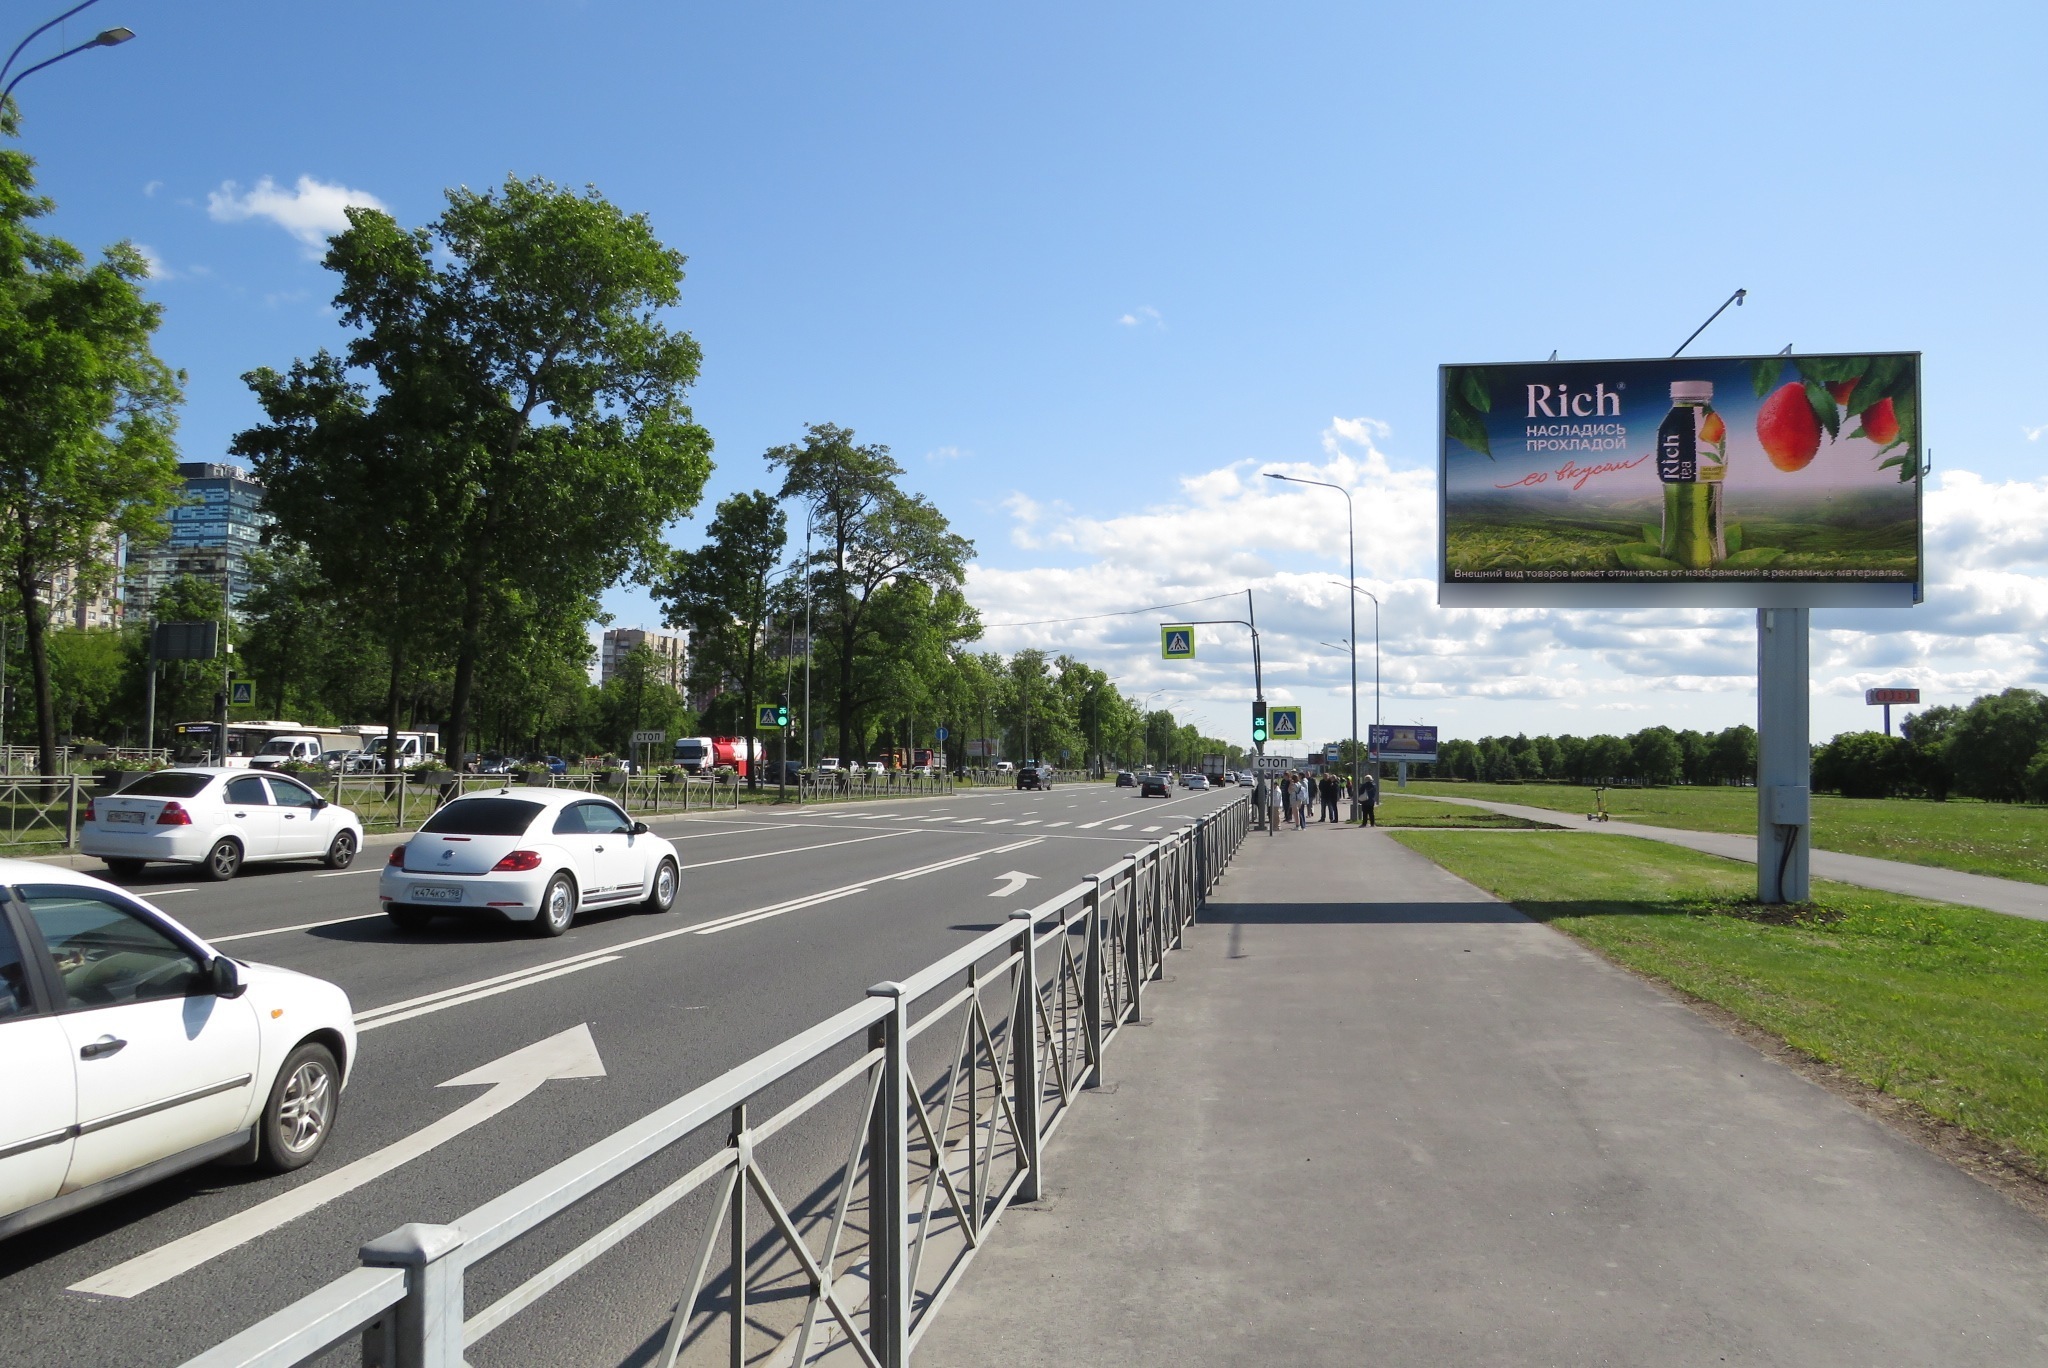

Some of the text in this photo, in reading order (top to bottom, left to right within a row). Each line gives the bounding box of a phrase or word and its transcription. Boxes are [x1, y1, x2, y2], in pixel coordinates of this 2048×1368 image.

[1525, 383, 1621, 418] Rich
[1526, 423, 1626, 437] НАСЛАДИСЬ
[1526, 437, 1626, 452] ПРОХЛАДОЙ
[1661, 434, 1680, 479] Rich
[1555, 460, 1649, 490] вкусом
[1681, 461, 1692, 479] tea
[1454, 568, 1502, 578] Внешний
[1505, 569, 1523, 580] вид
[1526, 569, 1569, 579] товаров
[1571, 569, 1605, 578] может
[1608, 569, 1668, 578] отличаться
[1671, 569, 1682, 577] от
[1685, 567, 1759, 579] изображений
[1771, 569, 1834, 579] рекламных
[636, 732, 660, 741] СТОП
[1258, 758, 1288, 768] СТОП
